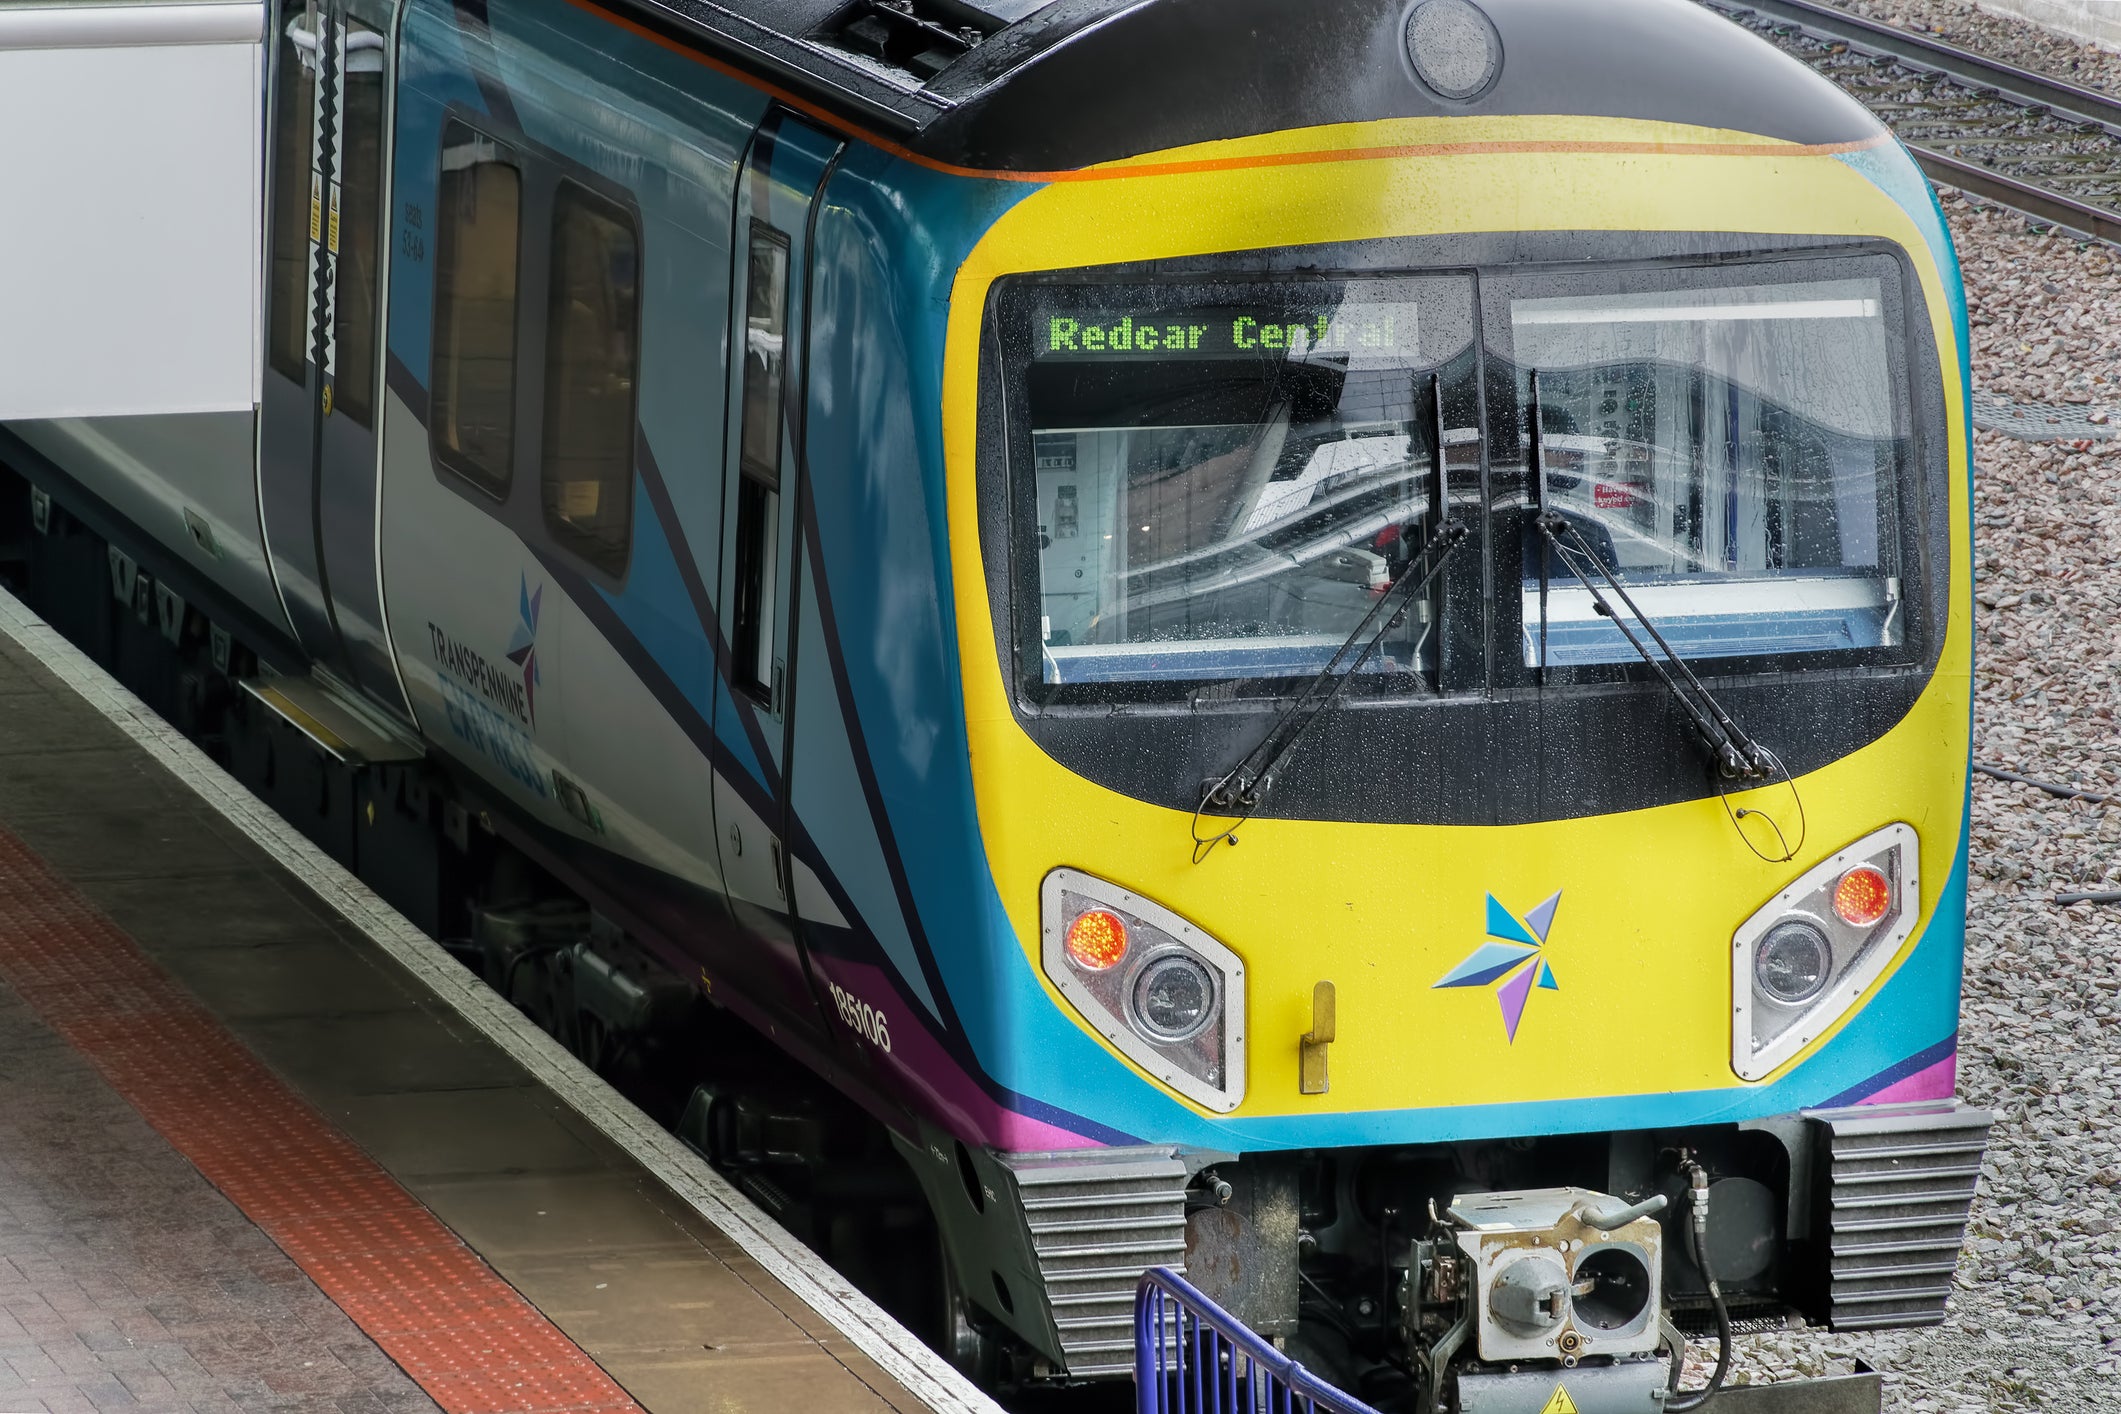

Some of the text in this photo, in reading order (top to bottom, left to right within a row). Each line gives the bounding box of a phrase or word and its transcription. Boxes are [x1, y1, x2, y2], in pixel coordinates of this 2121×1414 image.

[1049, 315, 1395, 351] Redcar Central
[428, 621, 528, 724] TRANSPENNINE
[829, 981, 891, 1053] 185106
